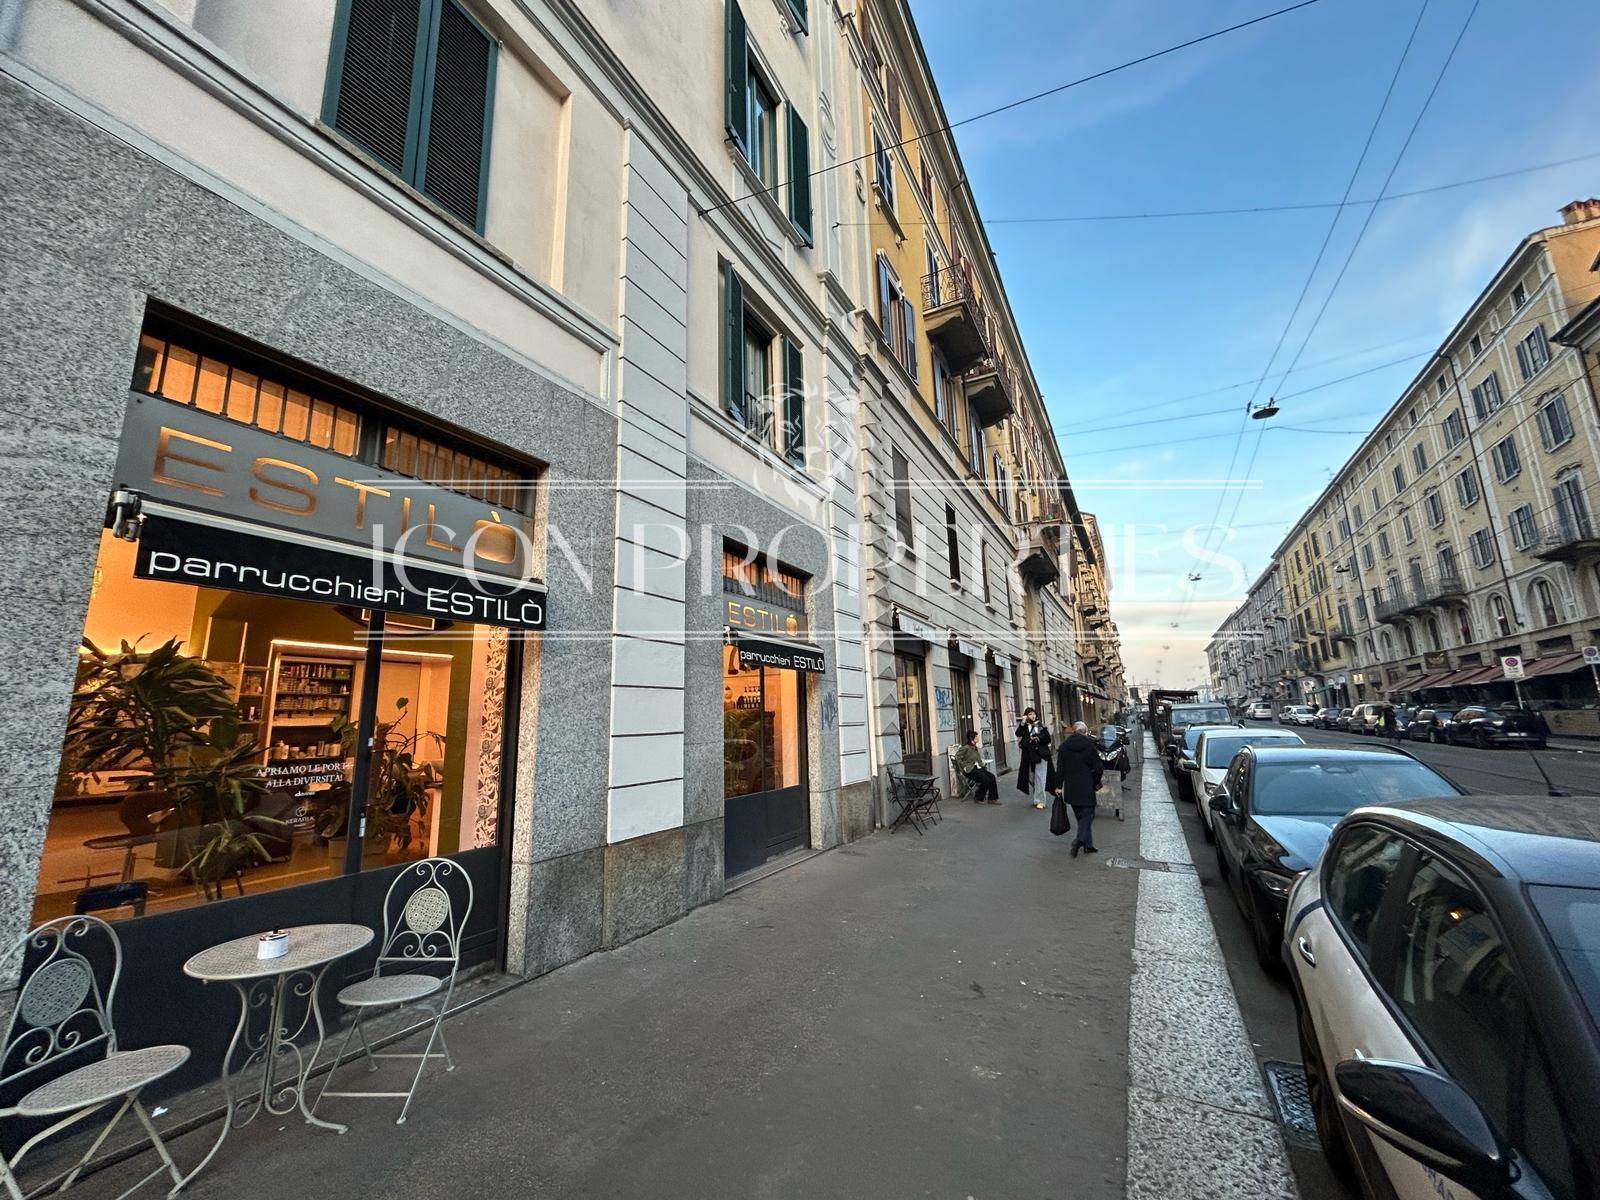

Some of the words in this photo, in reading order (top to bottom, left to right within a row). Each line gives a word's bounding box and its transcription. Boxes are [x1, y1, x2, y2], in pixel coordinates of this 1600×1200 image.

[152, 426, 516, 564] ESTILÒ
[147, 549, 406, 607] parrucchieri
[426, 587, 543, 625] ESTILÒ
[728, 601, 798, 636] ESTILÒ
[740, 650, 791, 667] parrucchieri
[793, 655, 825, 672] ESTILÒ
[255, 764, 307, 778] APRIAMO
[308, 763, 321, 773] LE
[265, 778, 293, 789] ALLA
